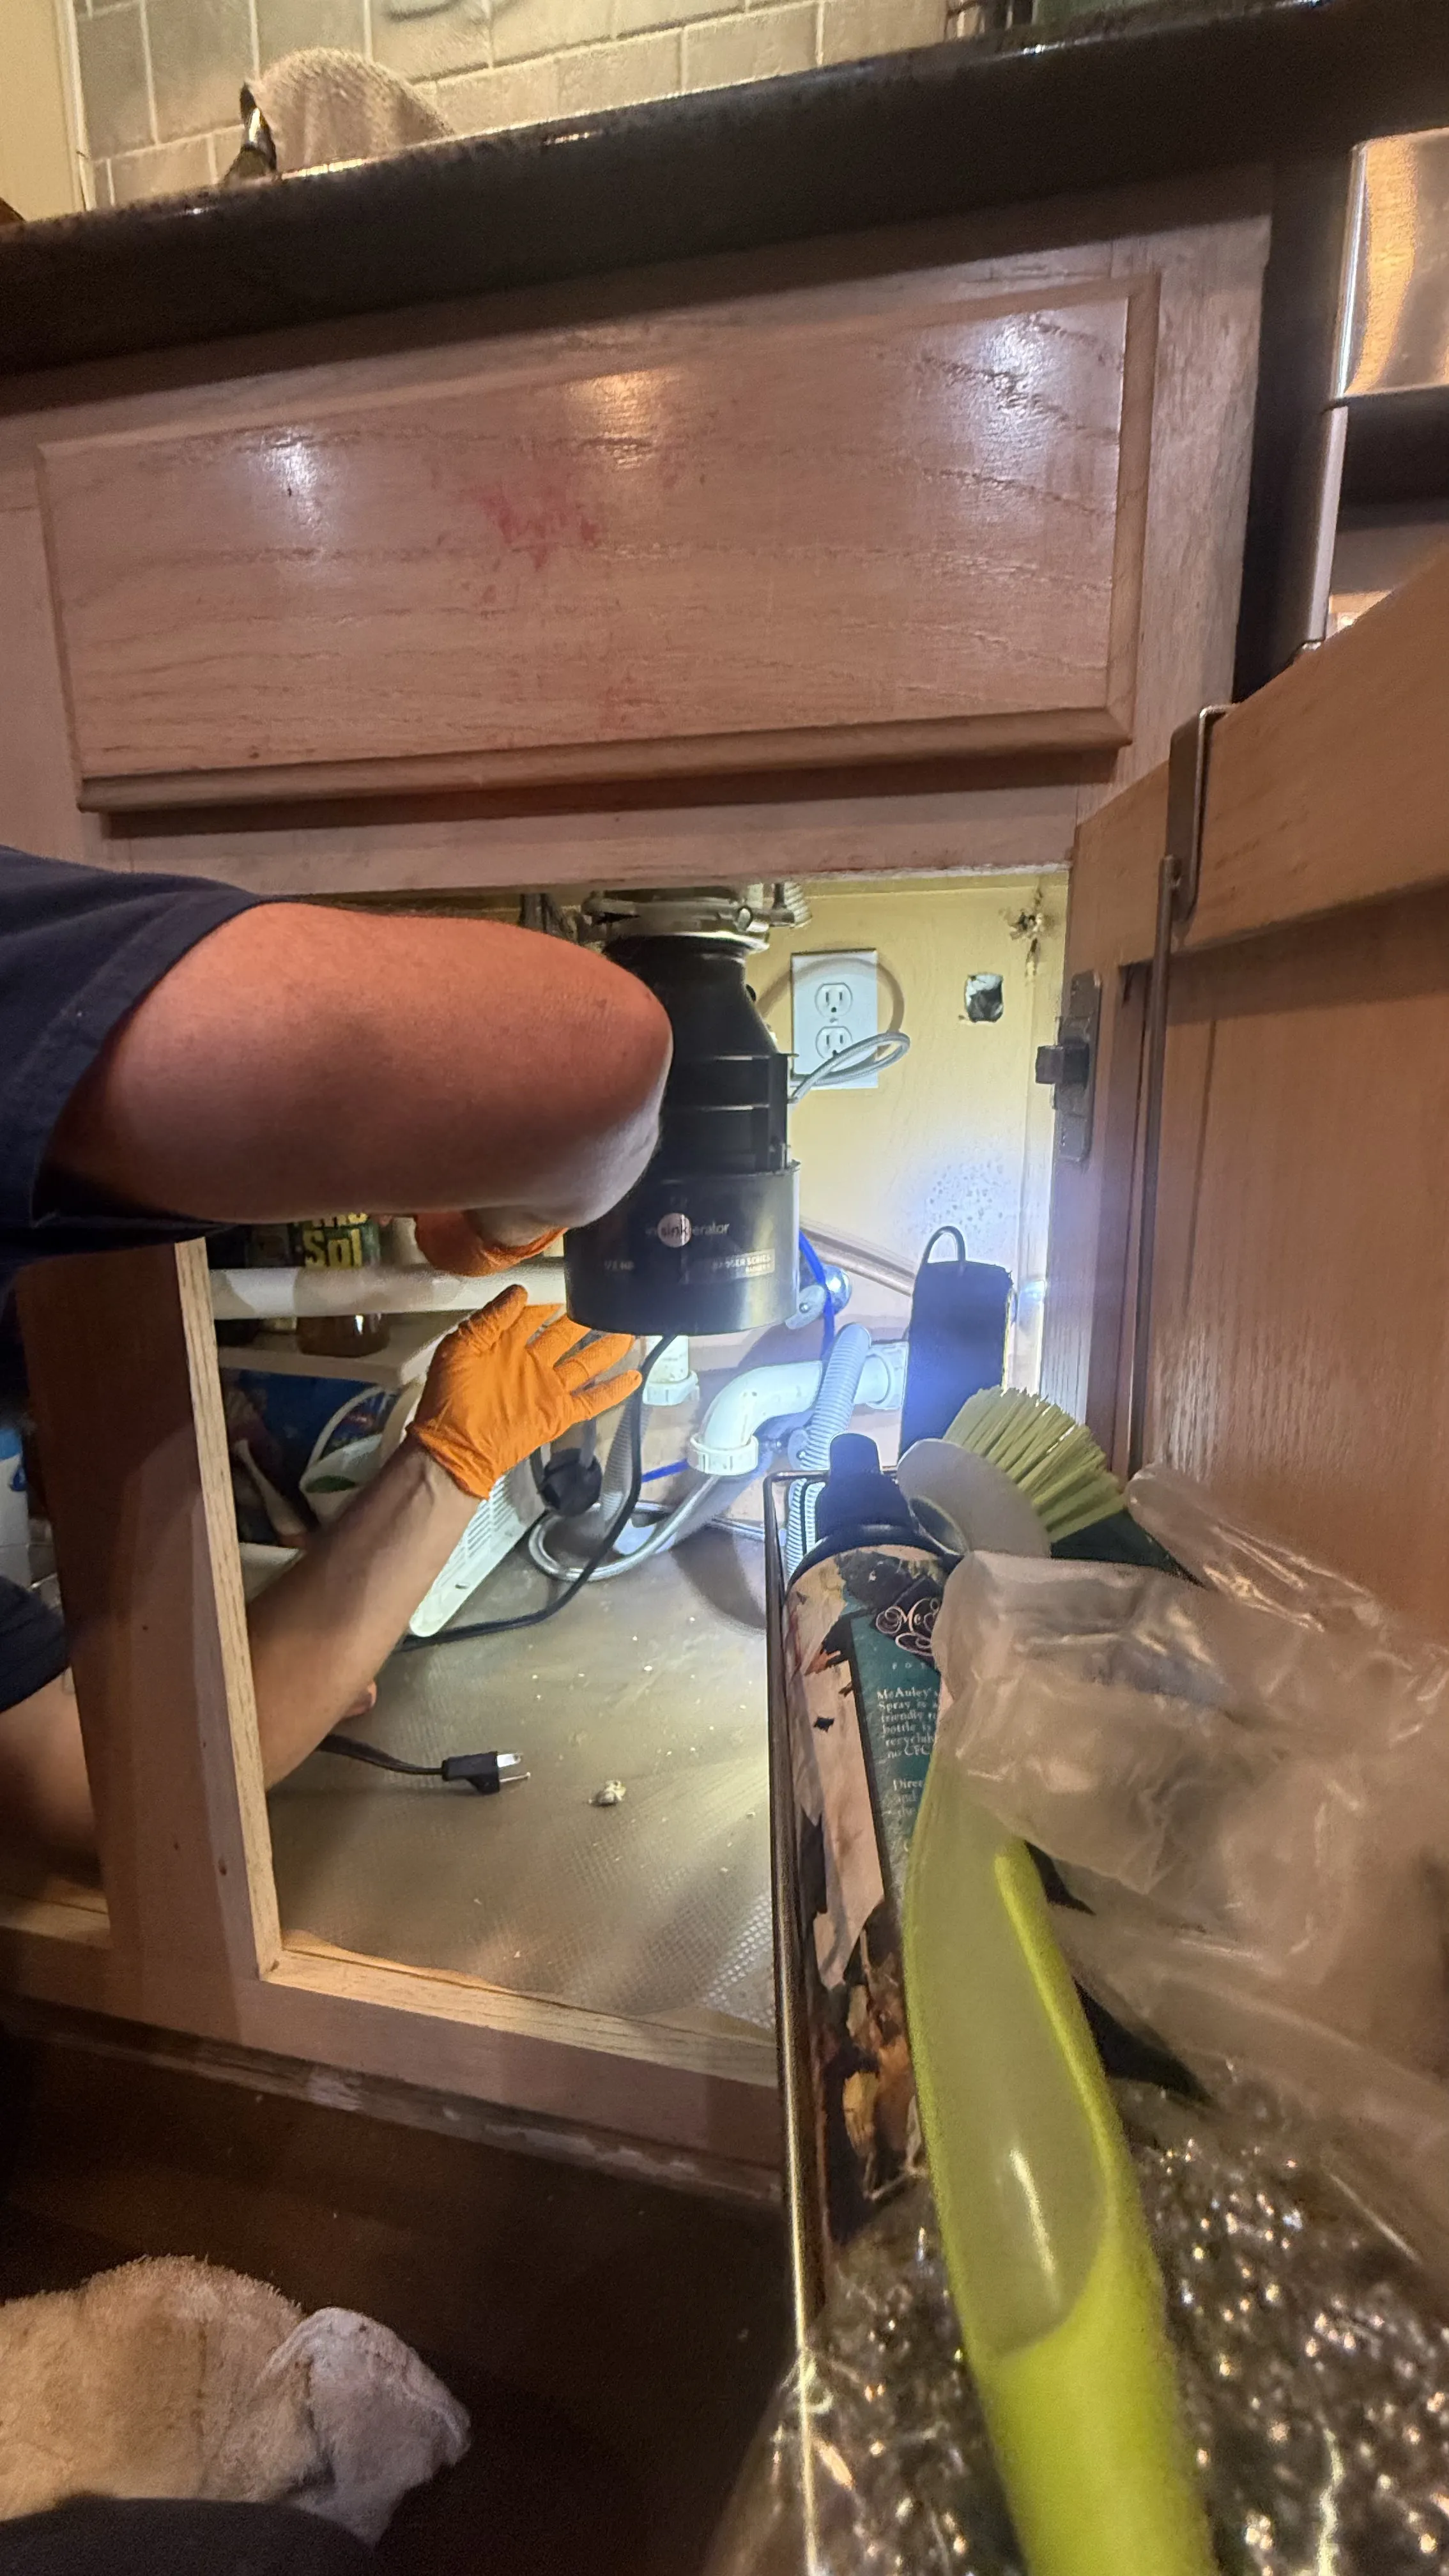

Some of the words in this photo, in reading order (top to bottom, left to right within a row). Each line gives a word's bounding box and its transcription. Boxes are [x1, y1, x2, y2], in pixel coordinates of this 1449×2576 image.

[303, 1228, 363, 1268] Sol
[878, 1701, 910, 1713] Spray
[882, 1721, 916, 1734] bottle
